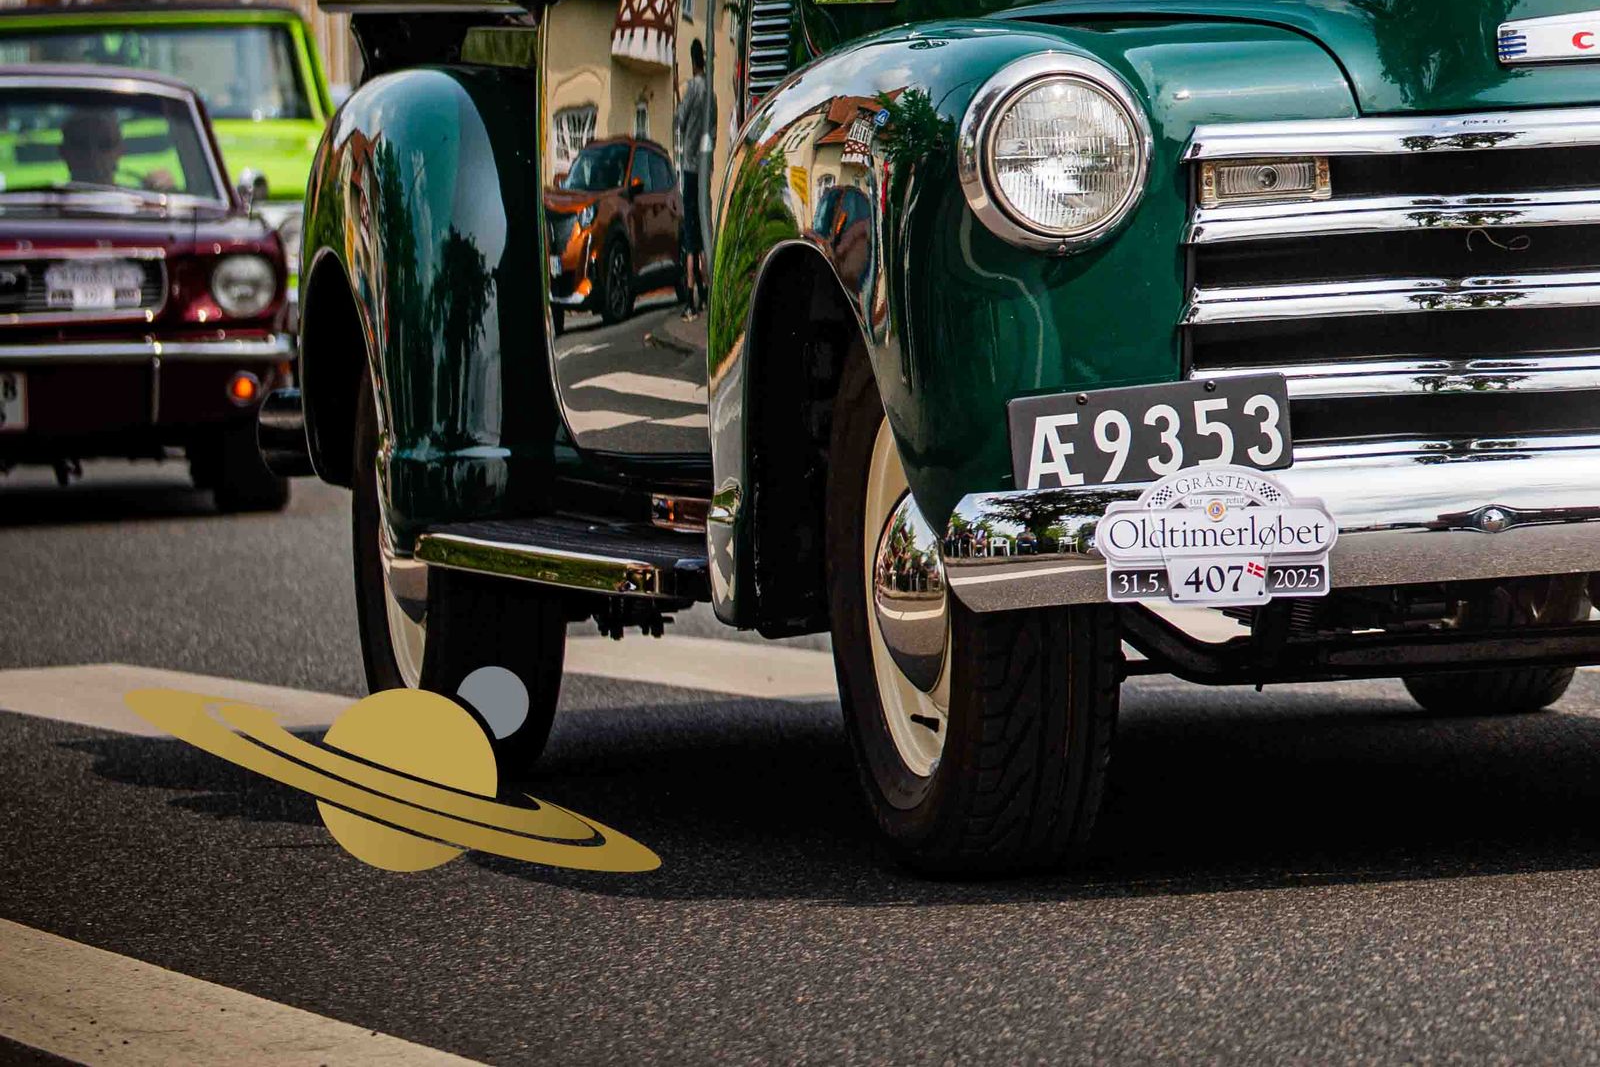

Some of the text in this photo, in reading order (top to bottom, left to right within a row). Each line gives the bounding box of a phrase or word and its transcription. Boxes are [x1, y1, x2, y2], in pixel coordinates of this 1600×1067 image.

[1026, 394, 1284, 490] Æ9353
[1175, 472, 1258, 494] GRÅSTEN
[1109, 515, 1326, 550] Oldtimerløbet
[1117, 572, 1166, 595] 31.5.
[1183, 565, 1244, 593] 407
[1274, 567, 1321, 589] 2025
